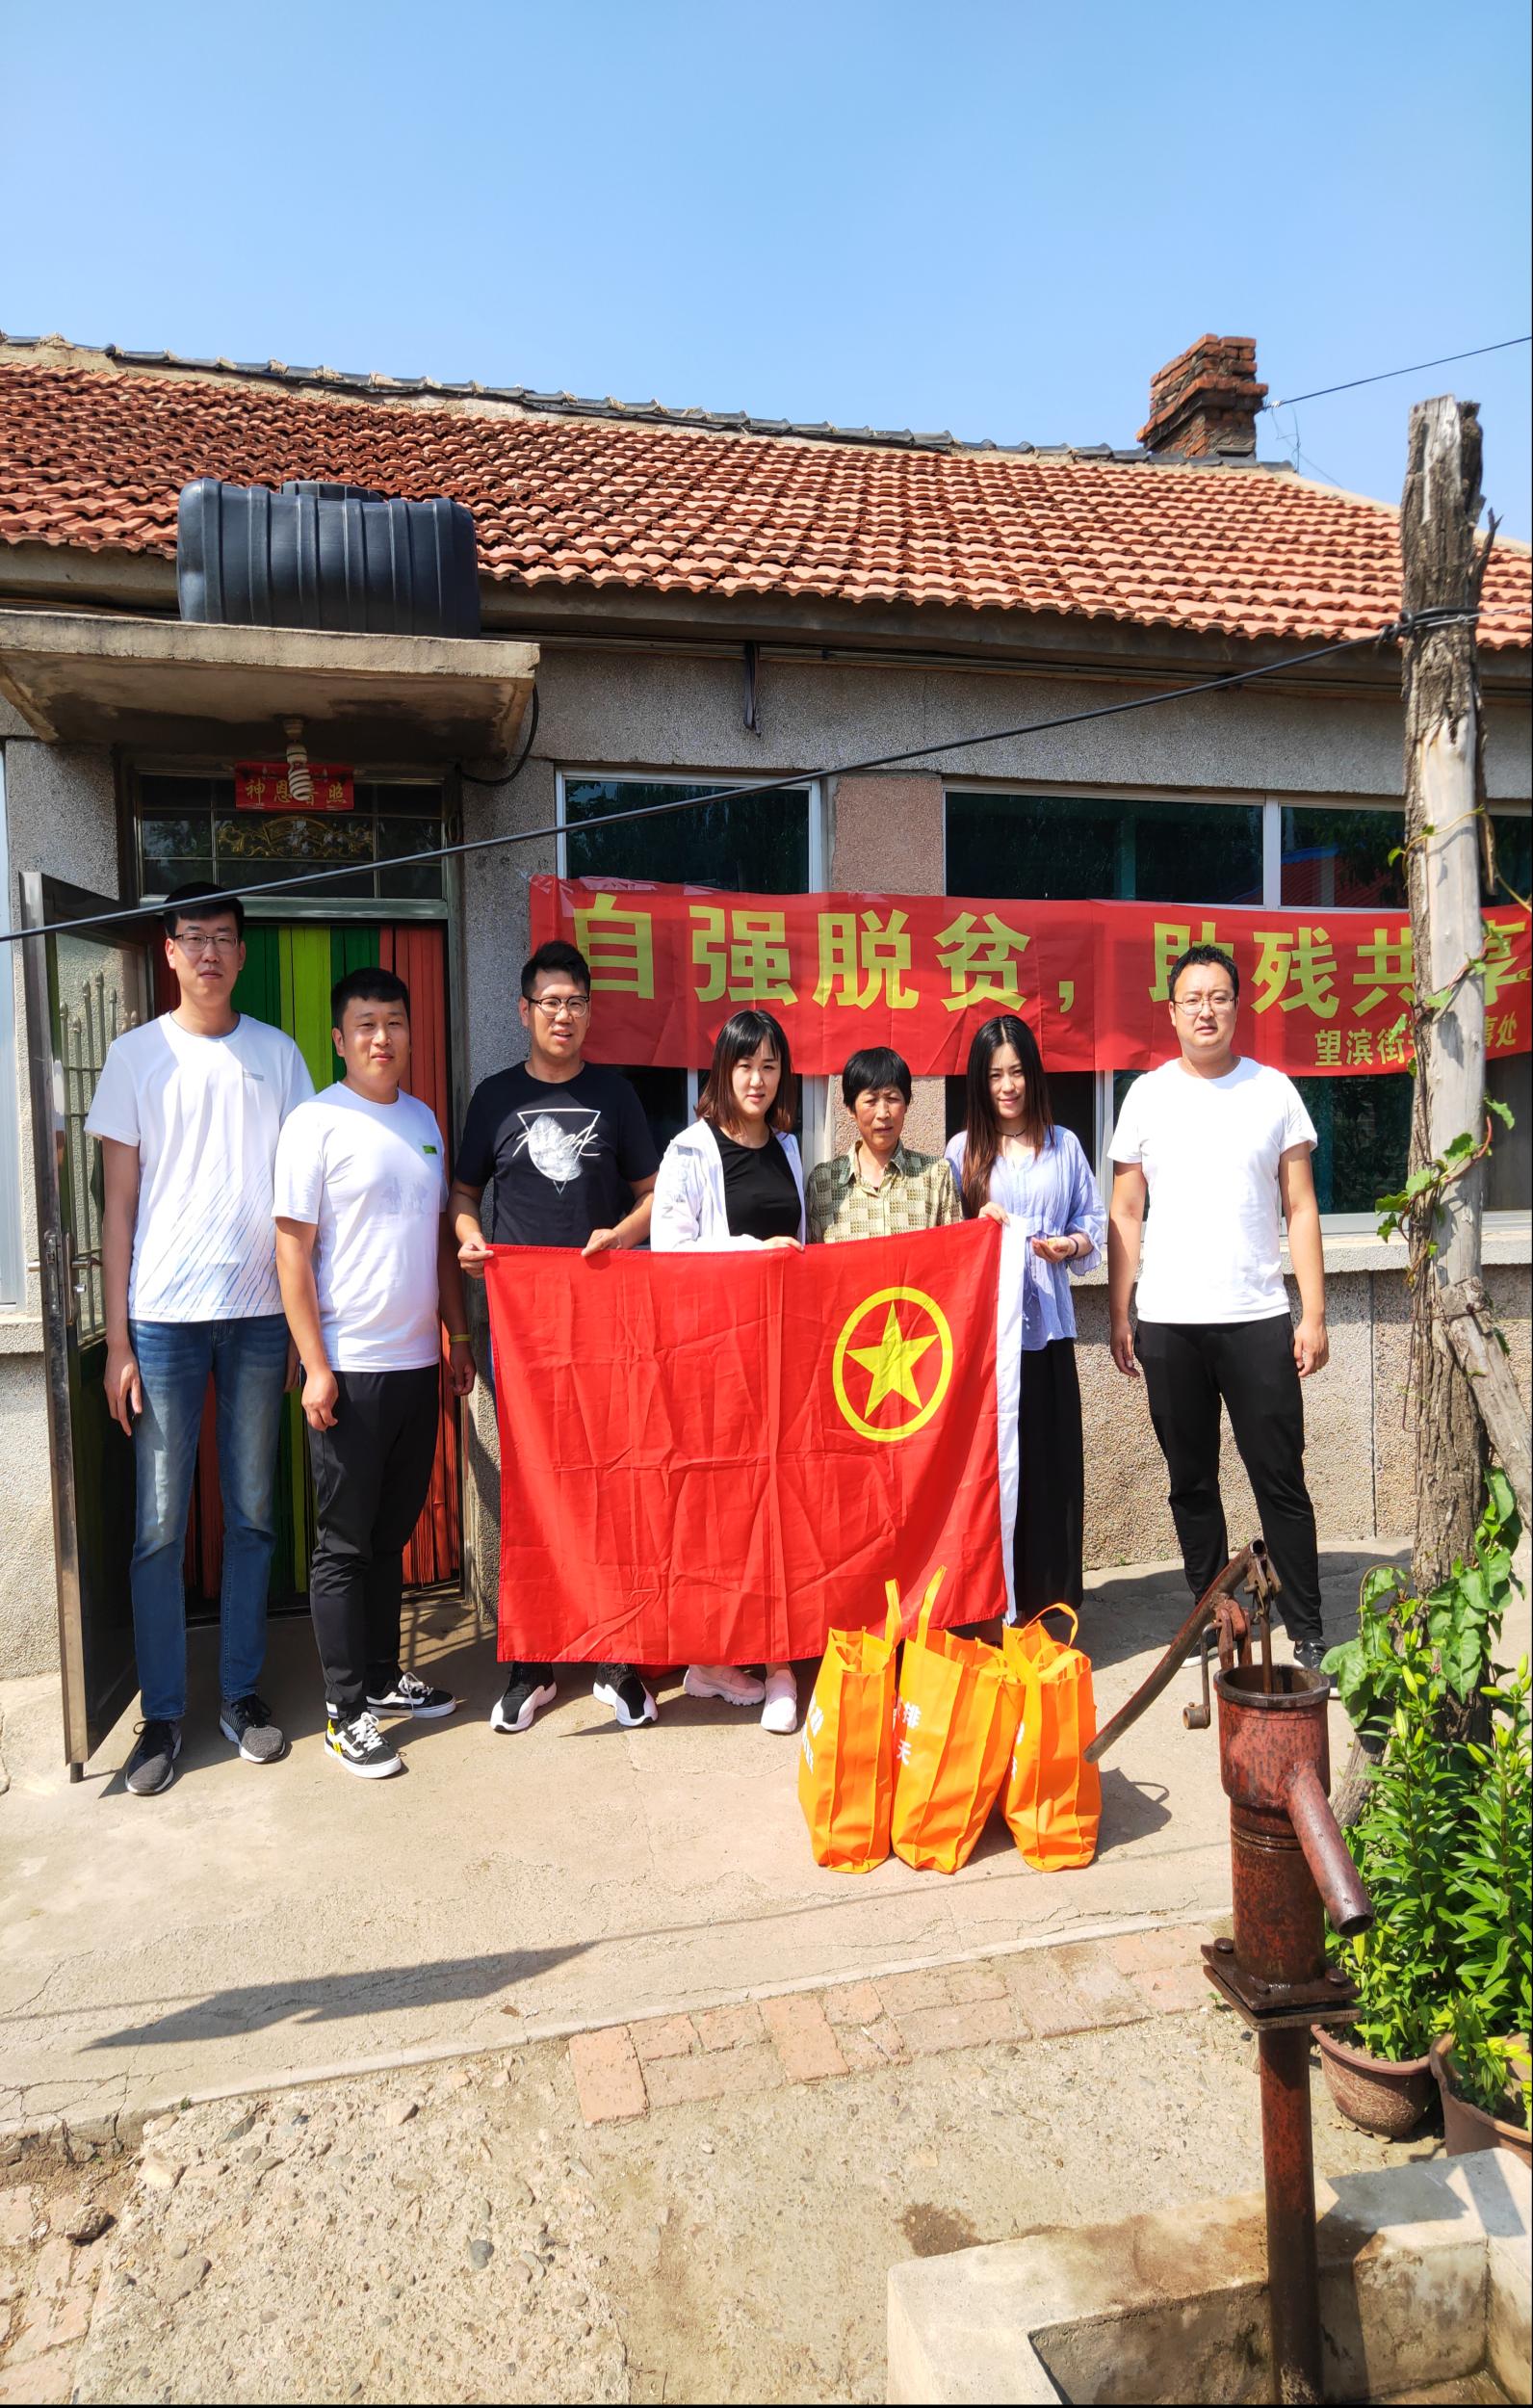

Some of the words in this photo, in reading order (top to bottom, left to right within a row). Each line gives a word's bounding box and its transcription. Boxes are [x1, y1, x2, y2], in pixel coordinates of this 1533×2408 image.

[1314, 1011, 1518, 1066] 望滨街事处
